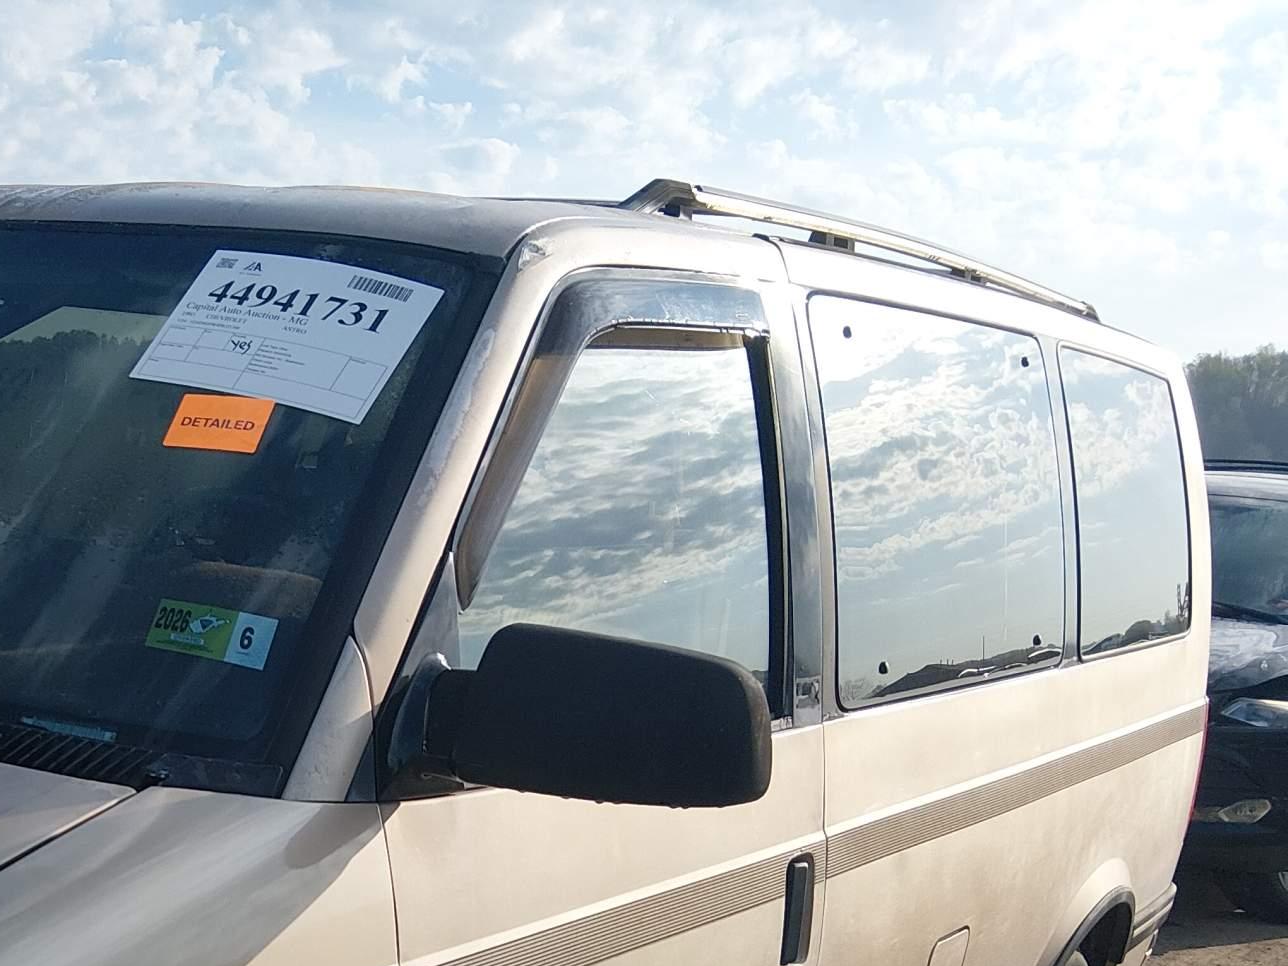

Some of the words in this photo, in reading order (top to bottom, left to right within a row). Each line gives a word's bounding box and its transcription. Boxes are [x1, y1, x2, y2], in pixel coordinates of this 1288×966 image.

[185, 302, 218, 313] Capital
[218, 304, 243, 316] Auto
[242, 310, 281, 322] Auction
[287, 315, 310, 327] MG
[207, 279, 390, 335] 44941731
[180, 415, 256, 432] DETAILED
[154, 606, 193, 633] 2026
[239, 626, 255, 650] 6
